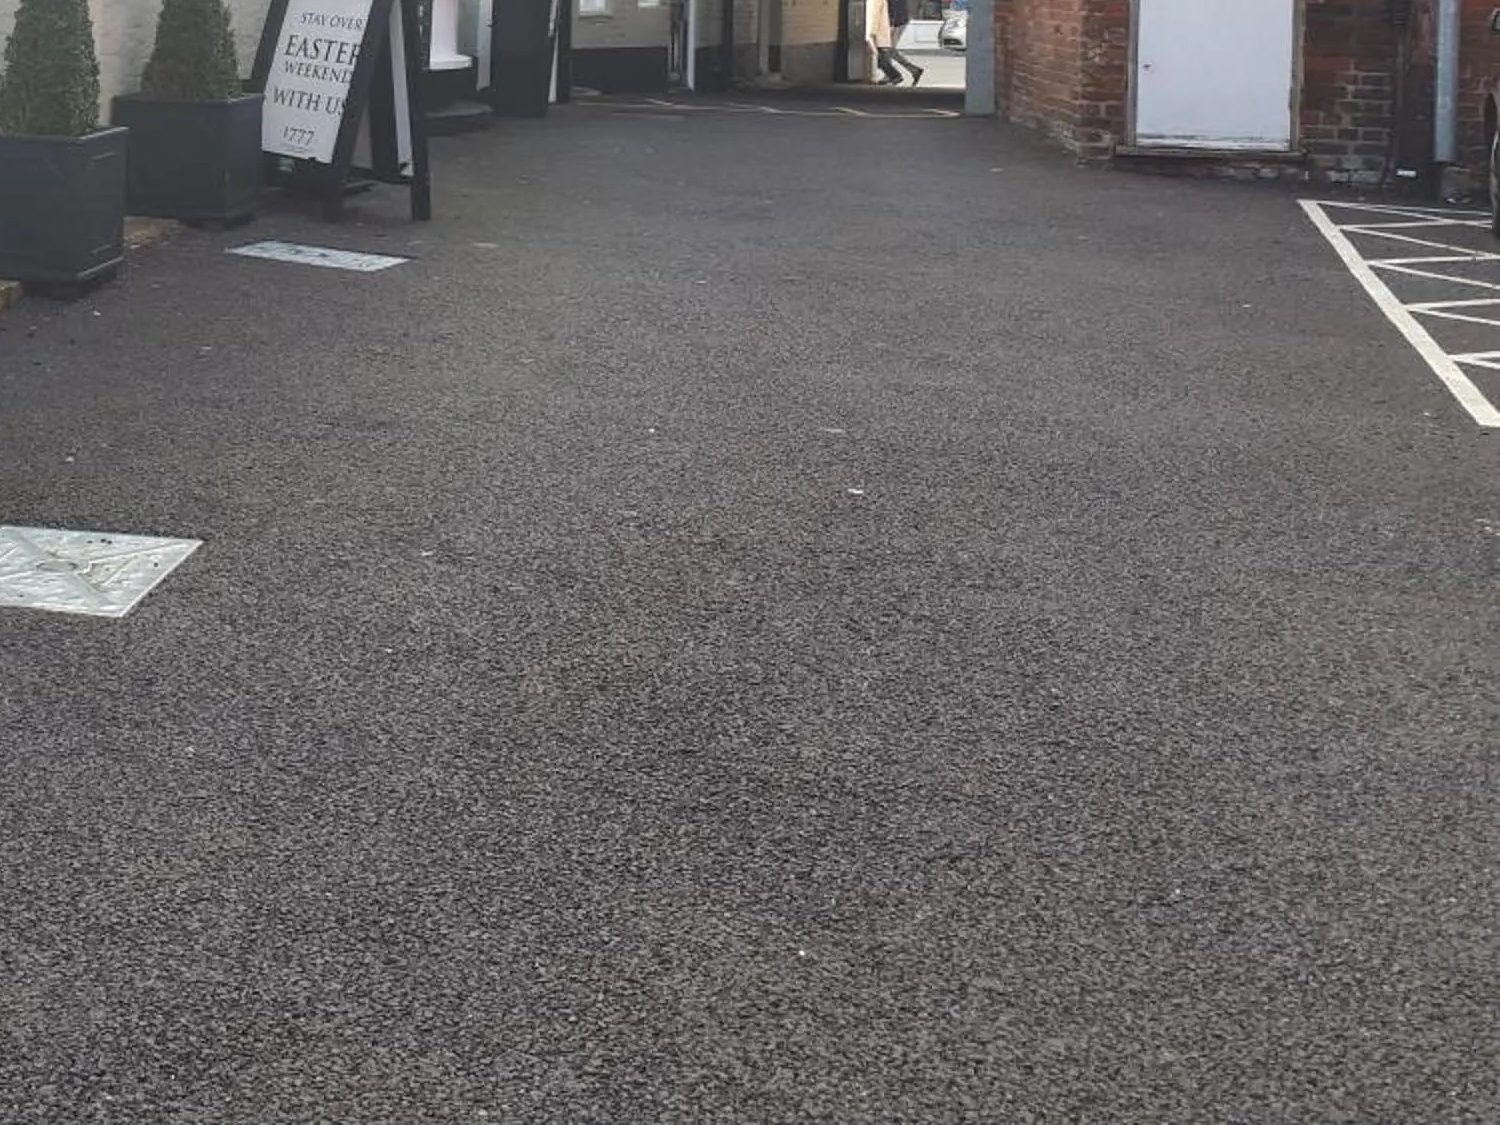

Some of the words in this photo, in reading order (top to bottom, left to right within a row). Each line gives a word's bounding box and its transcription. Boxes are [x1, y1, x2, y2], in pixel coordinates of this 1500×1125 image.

[300, 11, 325, 26] STAY
[329, 14, 363, 31] OVER
[273, 86, 321, 112] WITH
[283, 125, 315, 146] 1777
